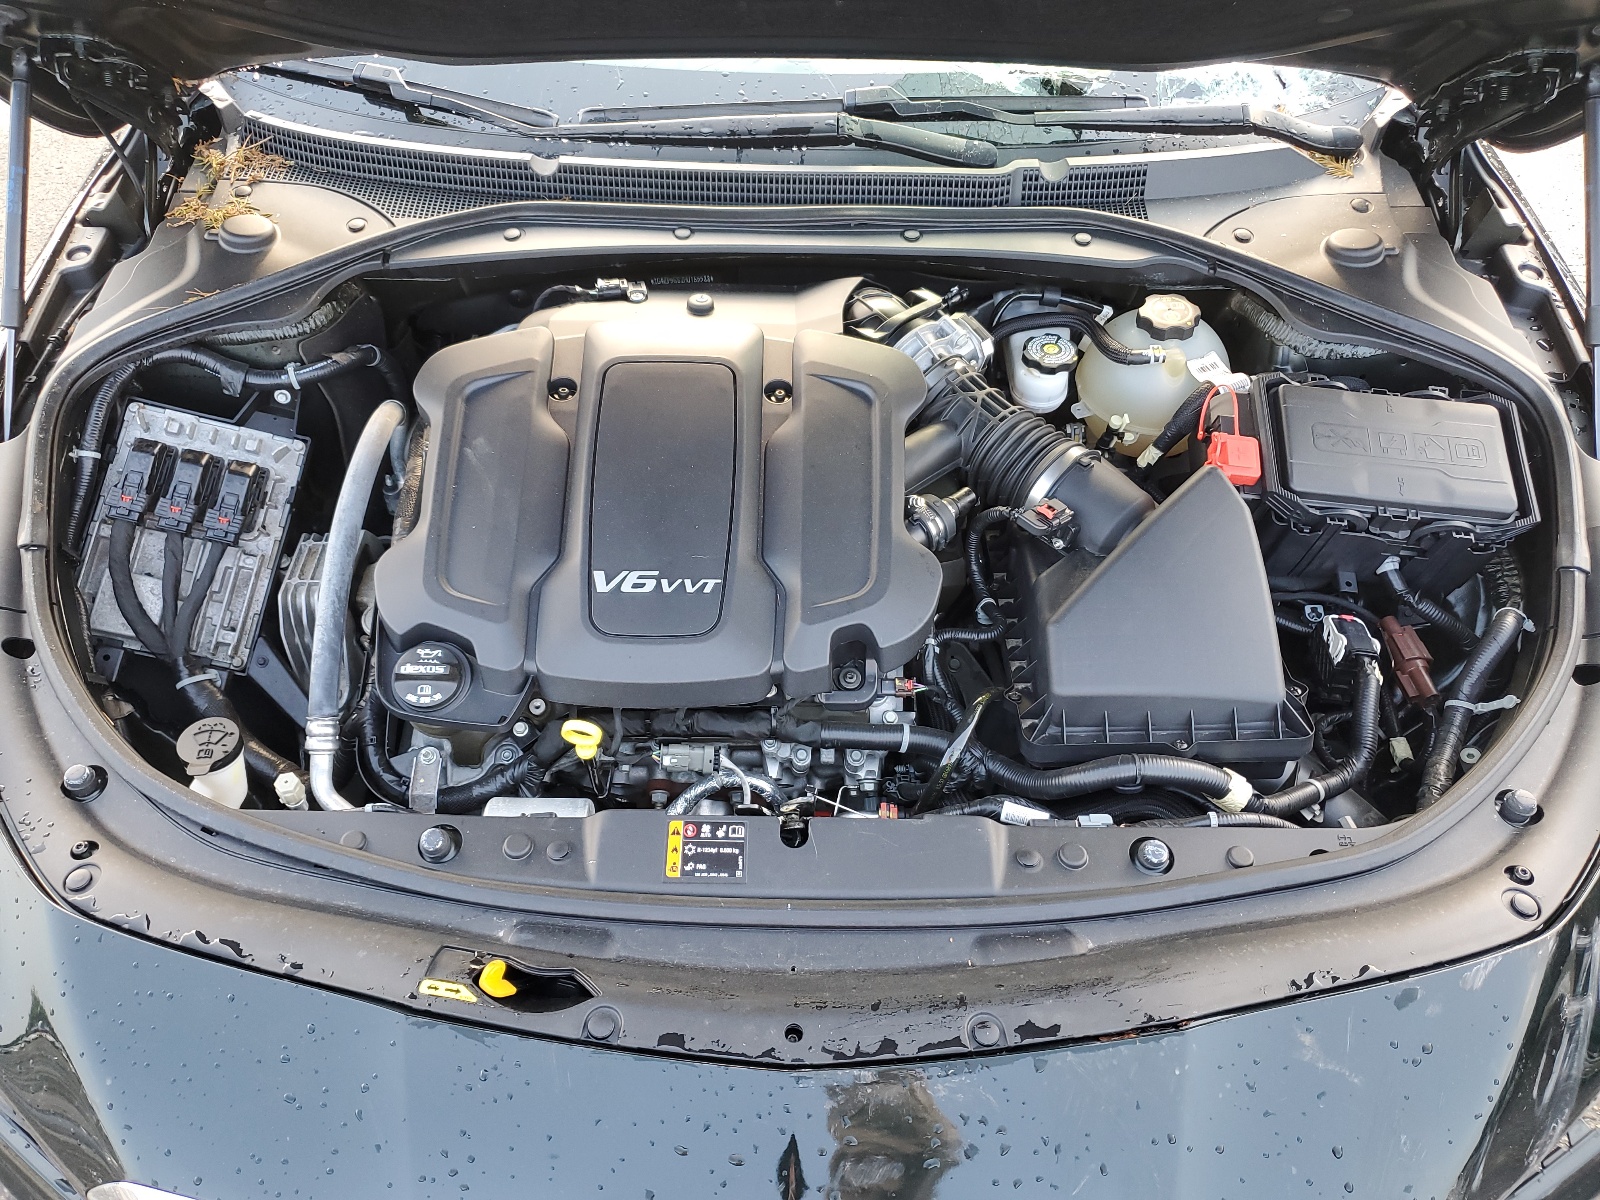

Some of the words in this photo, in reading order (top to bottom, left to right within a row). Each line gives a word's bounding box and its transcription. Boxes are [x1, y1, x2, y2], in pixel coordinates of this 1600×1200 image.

[592, 570, 660, 593] V6
[659, 578, 722, 594] VVT
[400, 663, 446, 674] dexos
